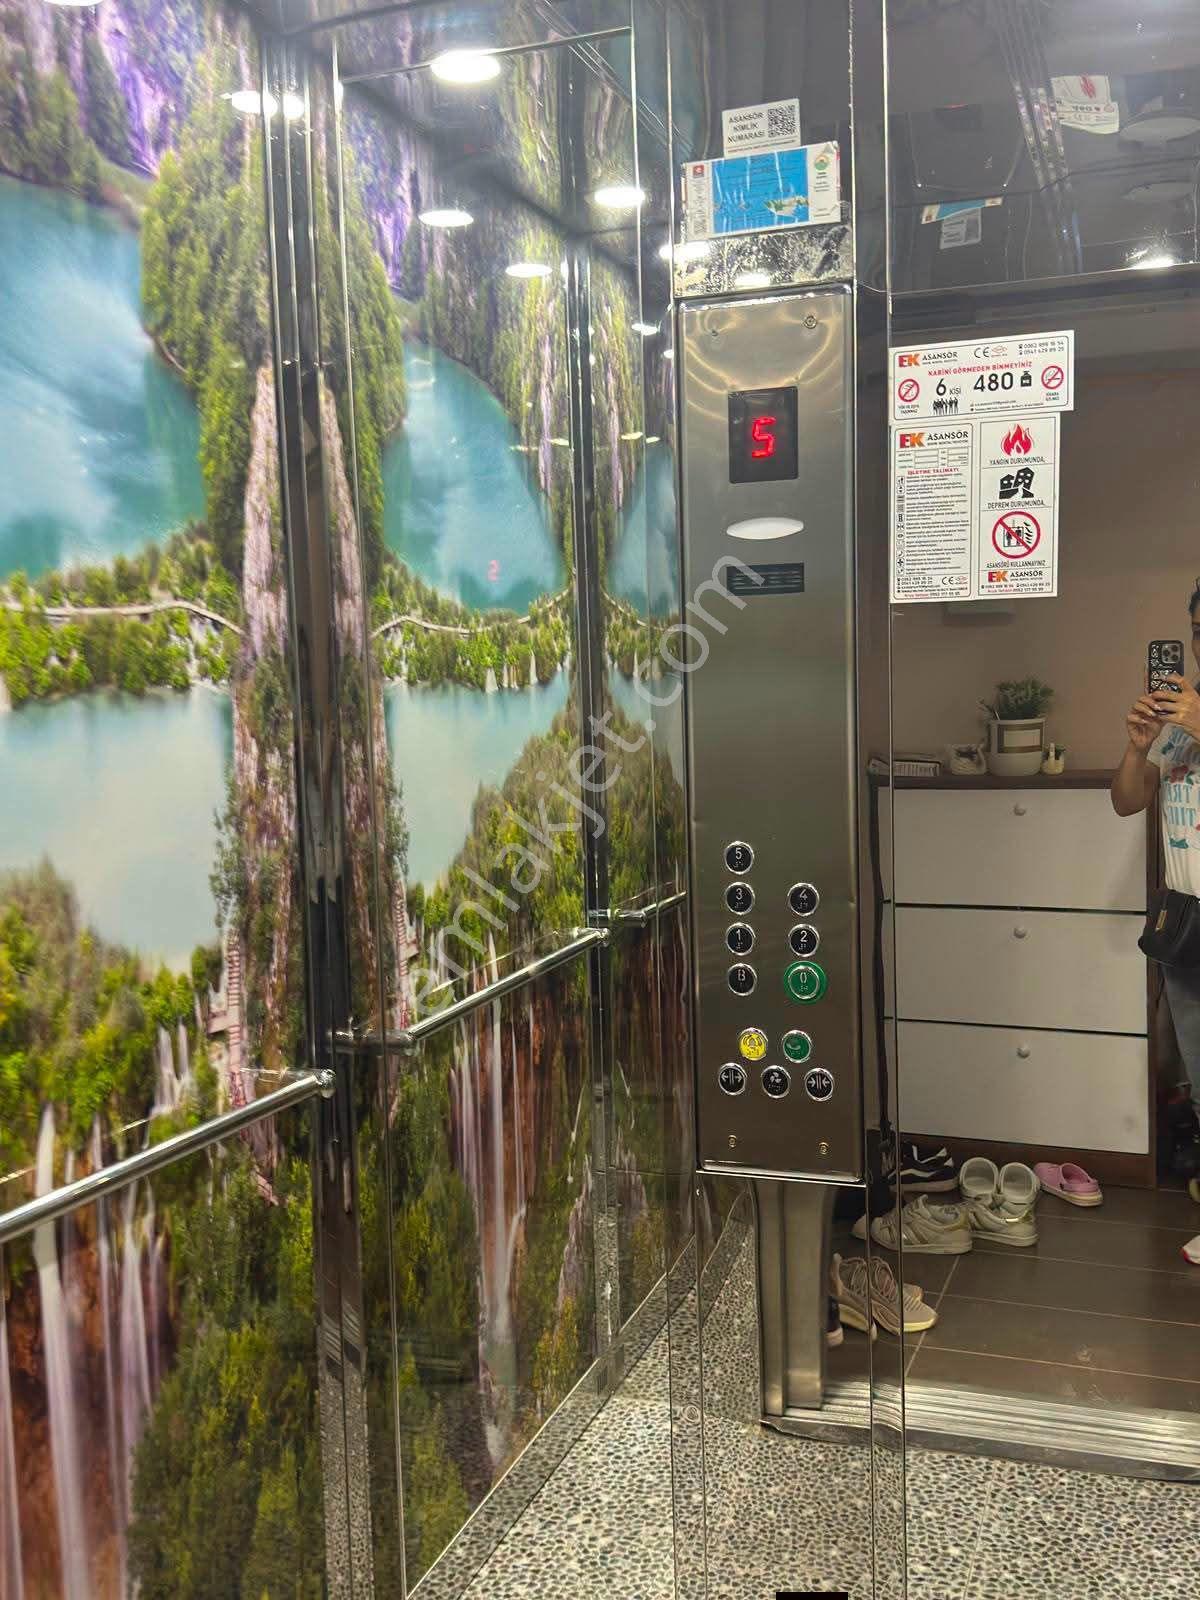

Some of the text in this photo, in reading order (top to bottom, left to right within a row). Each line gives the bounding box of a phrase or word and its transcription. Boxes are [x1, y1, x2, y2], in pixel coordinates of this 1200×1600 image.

[898, 353, 920, 367] EK
[991, 360, 1032, 370] BİNMEYİNİZ
[936, 377, 947, 396] 6
[973, 371, 1014, 392] 480
[751, 416, 776, 458] 5
[899, 432, 926, 449] EK
[987, 570, 1008, 583] EK
[735, 847, 743, 860] 5
[735, 887, 808, 900] 3 4
[735, 928, 808, 943] 1 2
[737, 969, 808, 984] B 0
